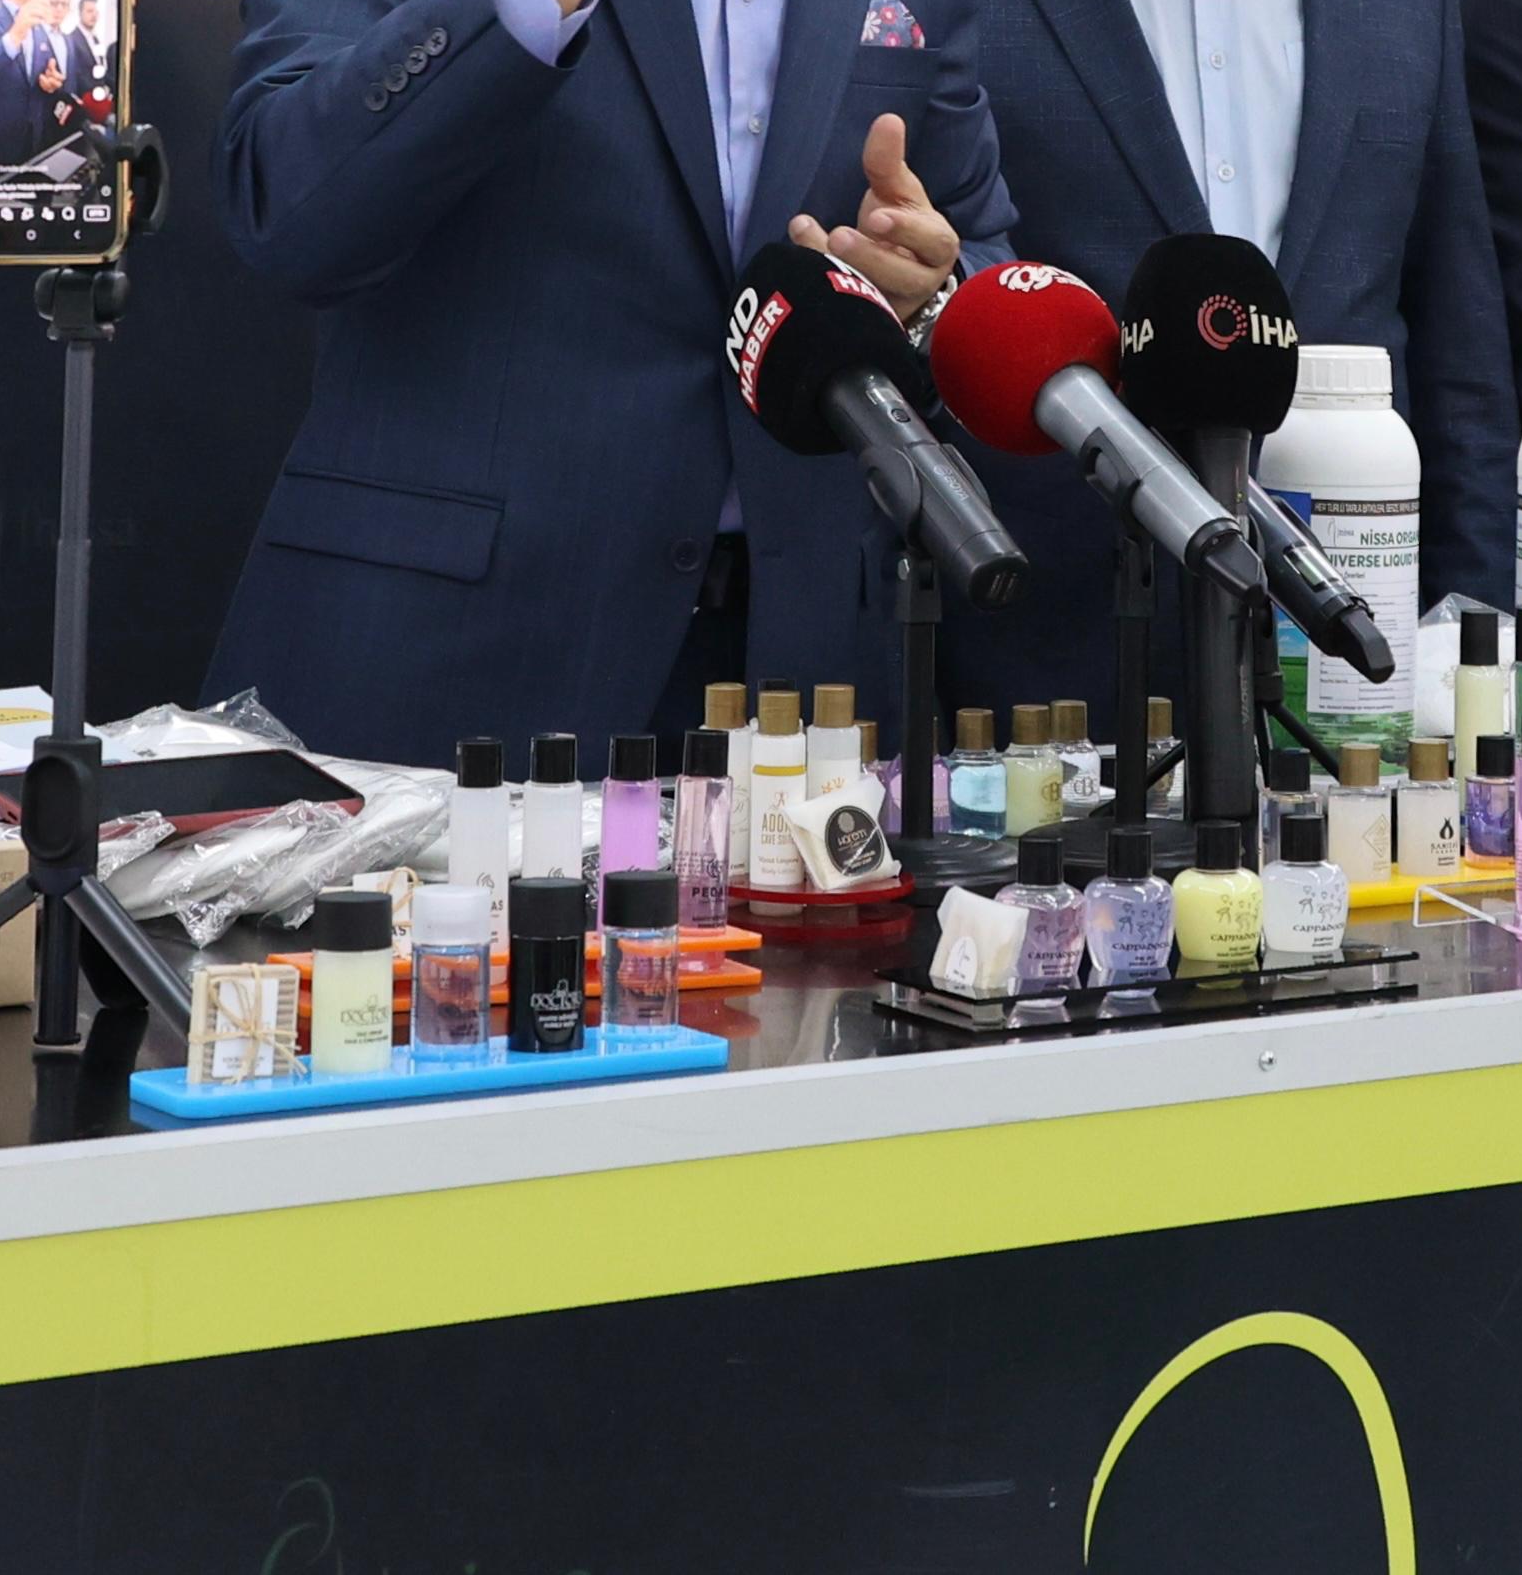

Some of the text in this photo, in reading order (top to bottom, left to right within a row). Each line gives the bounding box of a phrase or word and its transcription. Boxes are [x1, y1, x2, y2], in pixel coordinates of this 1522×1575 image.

[726, 287, 759, 374] ND
[741, 300, 784, 405] HABER
[1250, 305, 1298, 350] İHA
[1360, 528, 1395, 545] NİSSA
